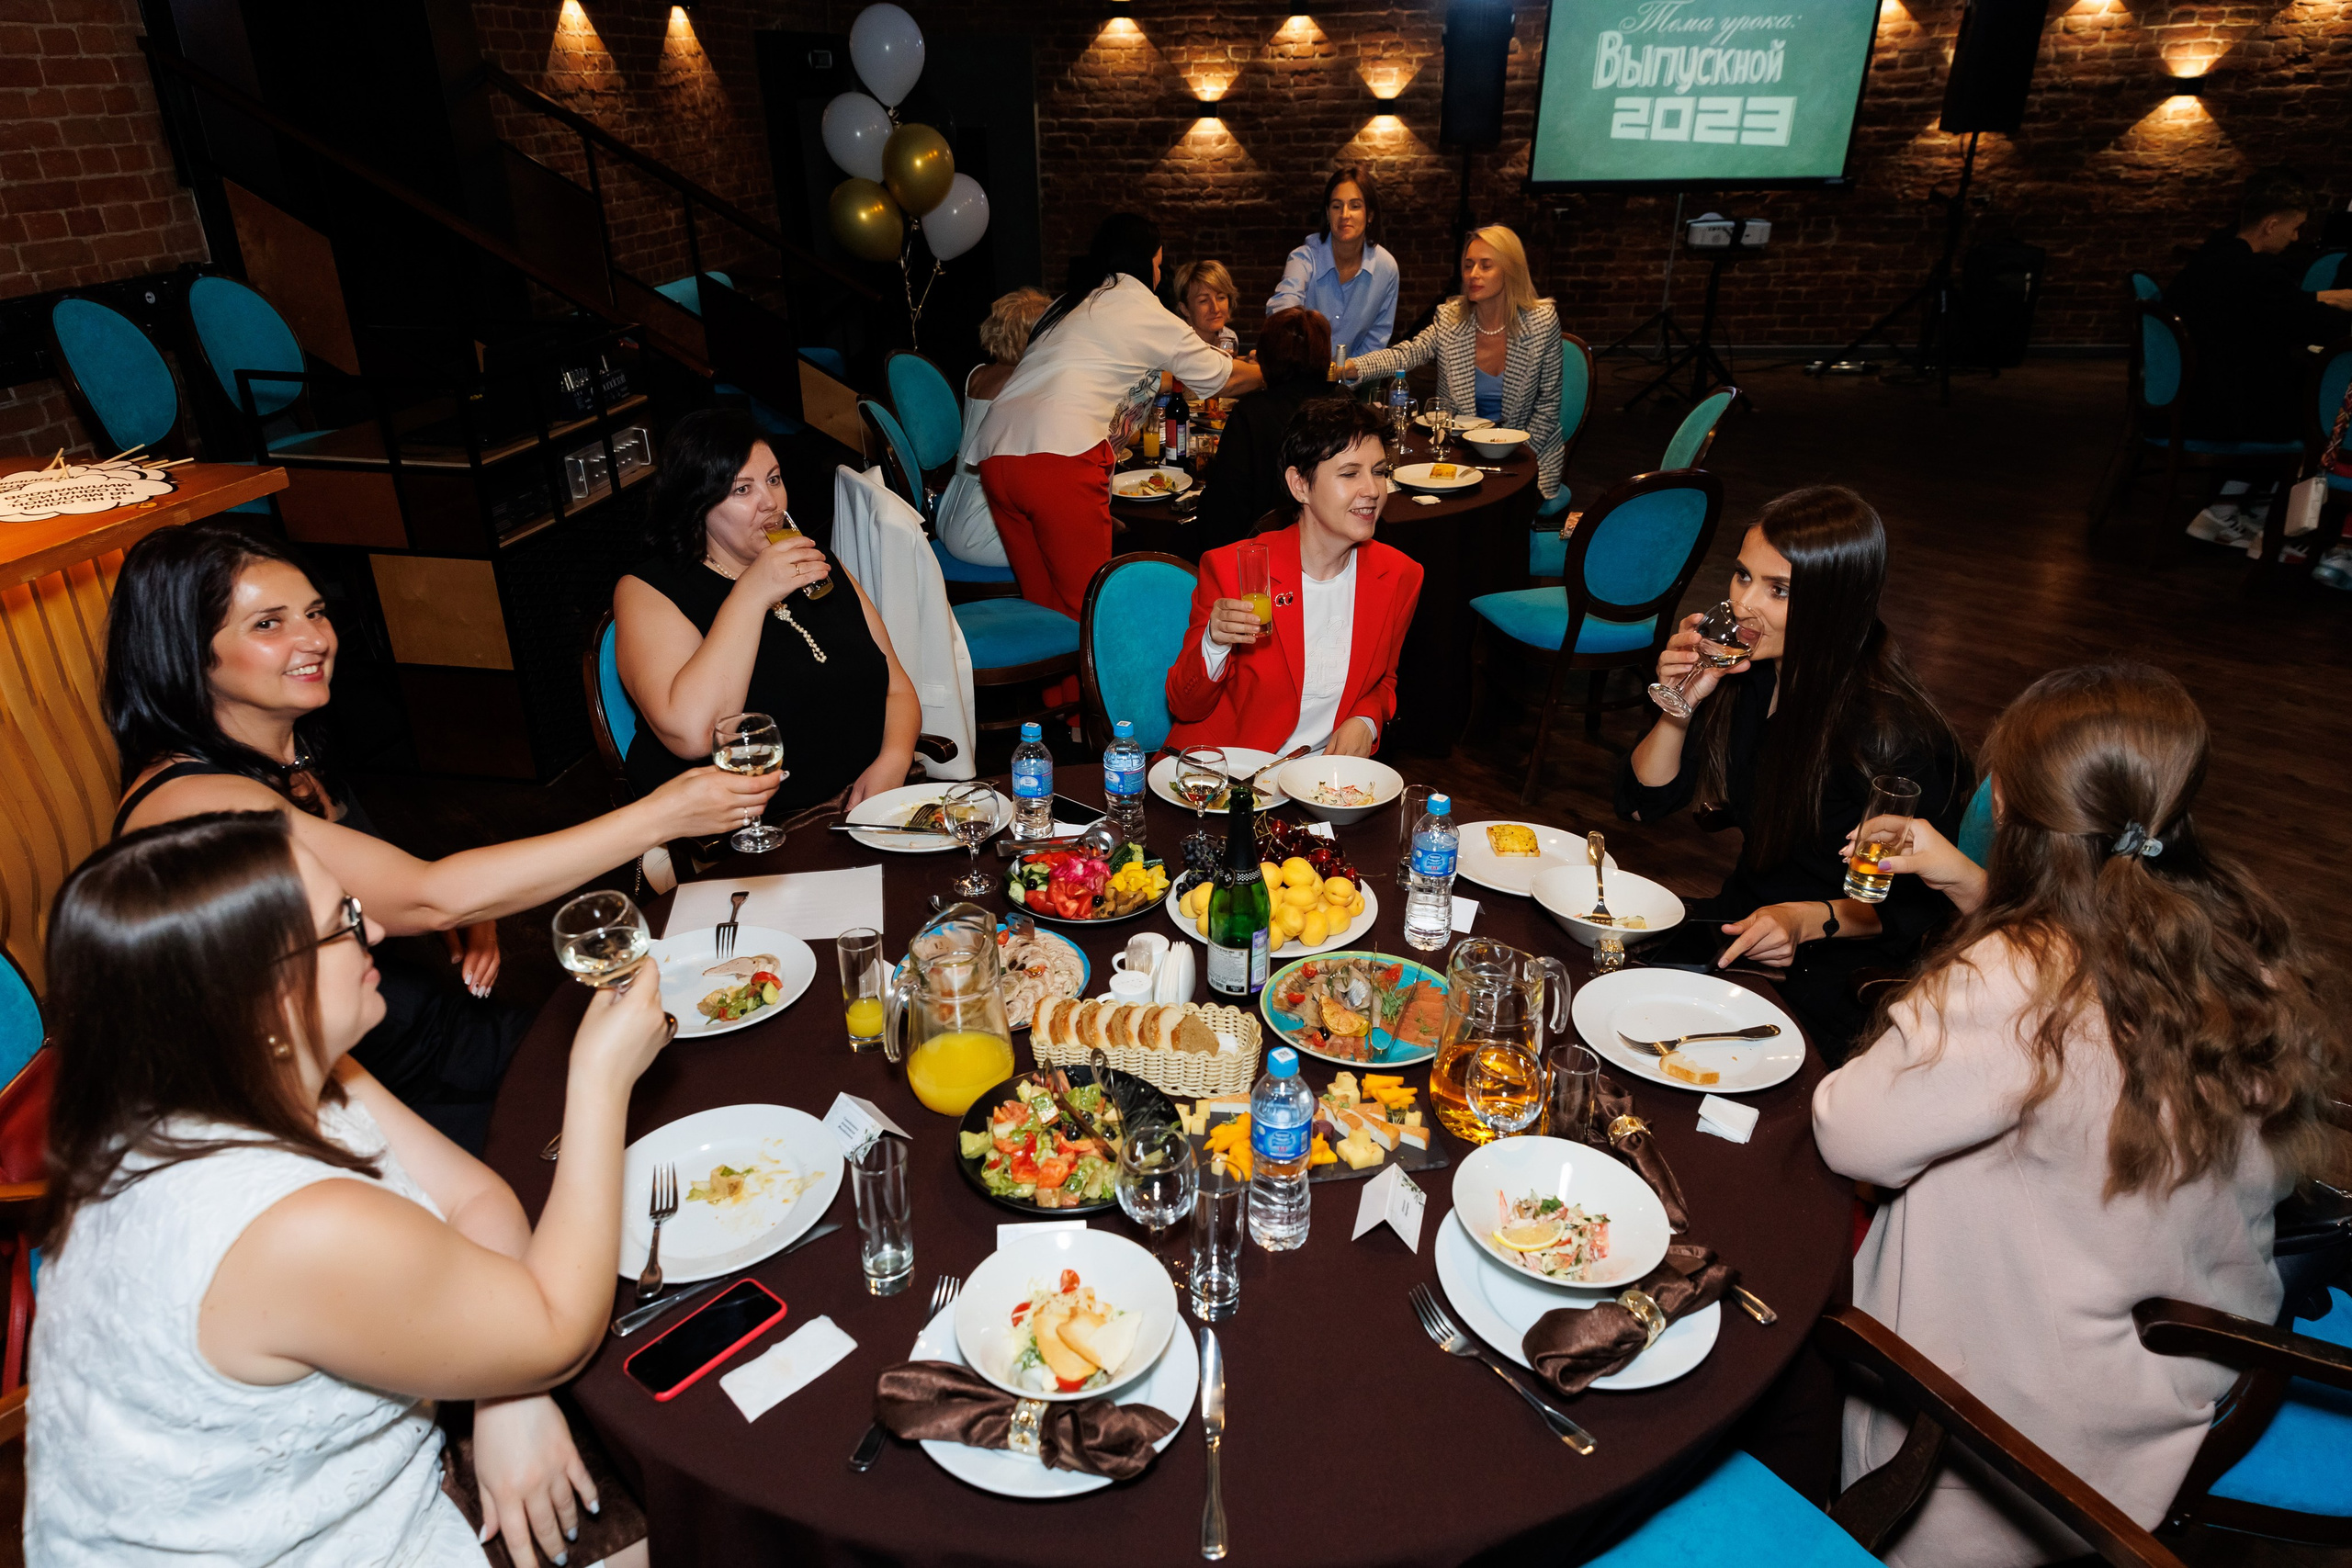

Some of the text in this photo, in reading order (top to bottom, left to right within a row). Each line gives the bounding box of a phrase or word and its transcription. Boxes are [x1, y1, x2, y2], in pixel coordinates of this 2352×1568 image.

[1619, 0, 1803, 45] Тема урока:
[1592, 30, 1787, 95] Выпускной
[1610, 96, 1798, 147] 2023
[4, 483, 131, 500] МИЛЛИАРДОВ
[24, 500, 74, 510] ОДНА
[59, 488, 109, 496] ОДНА
